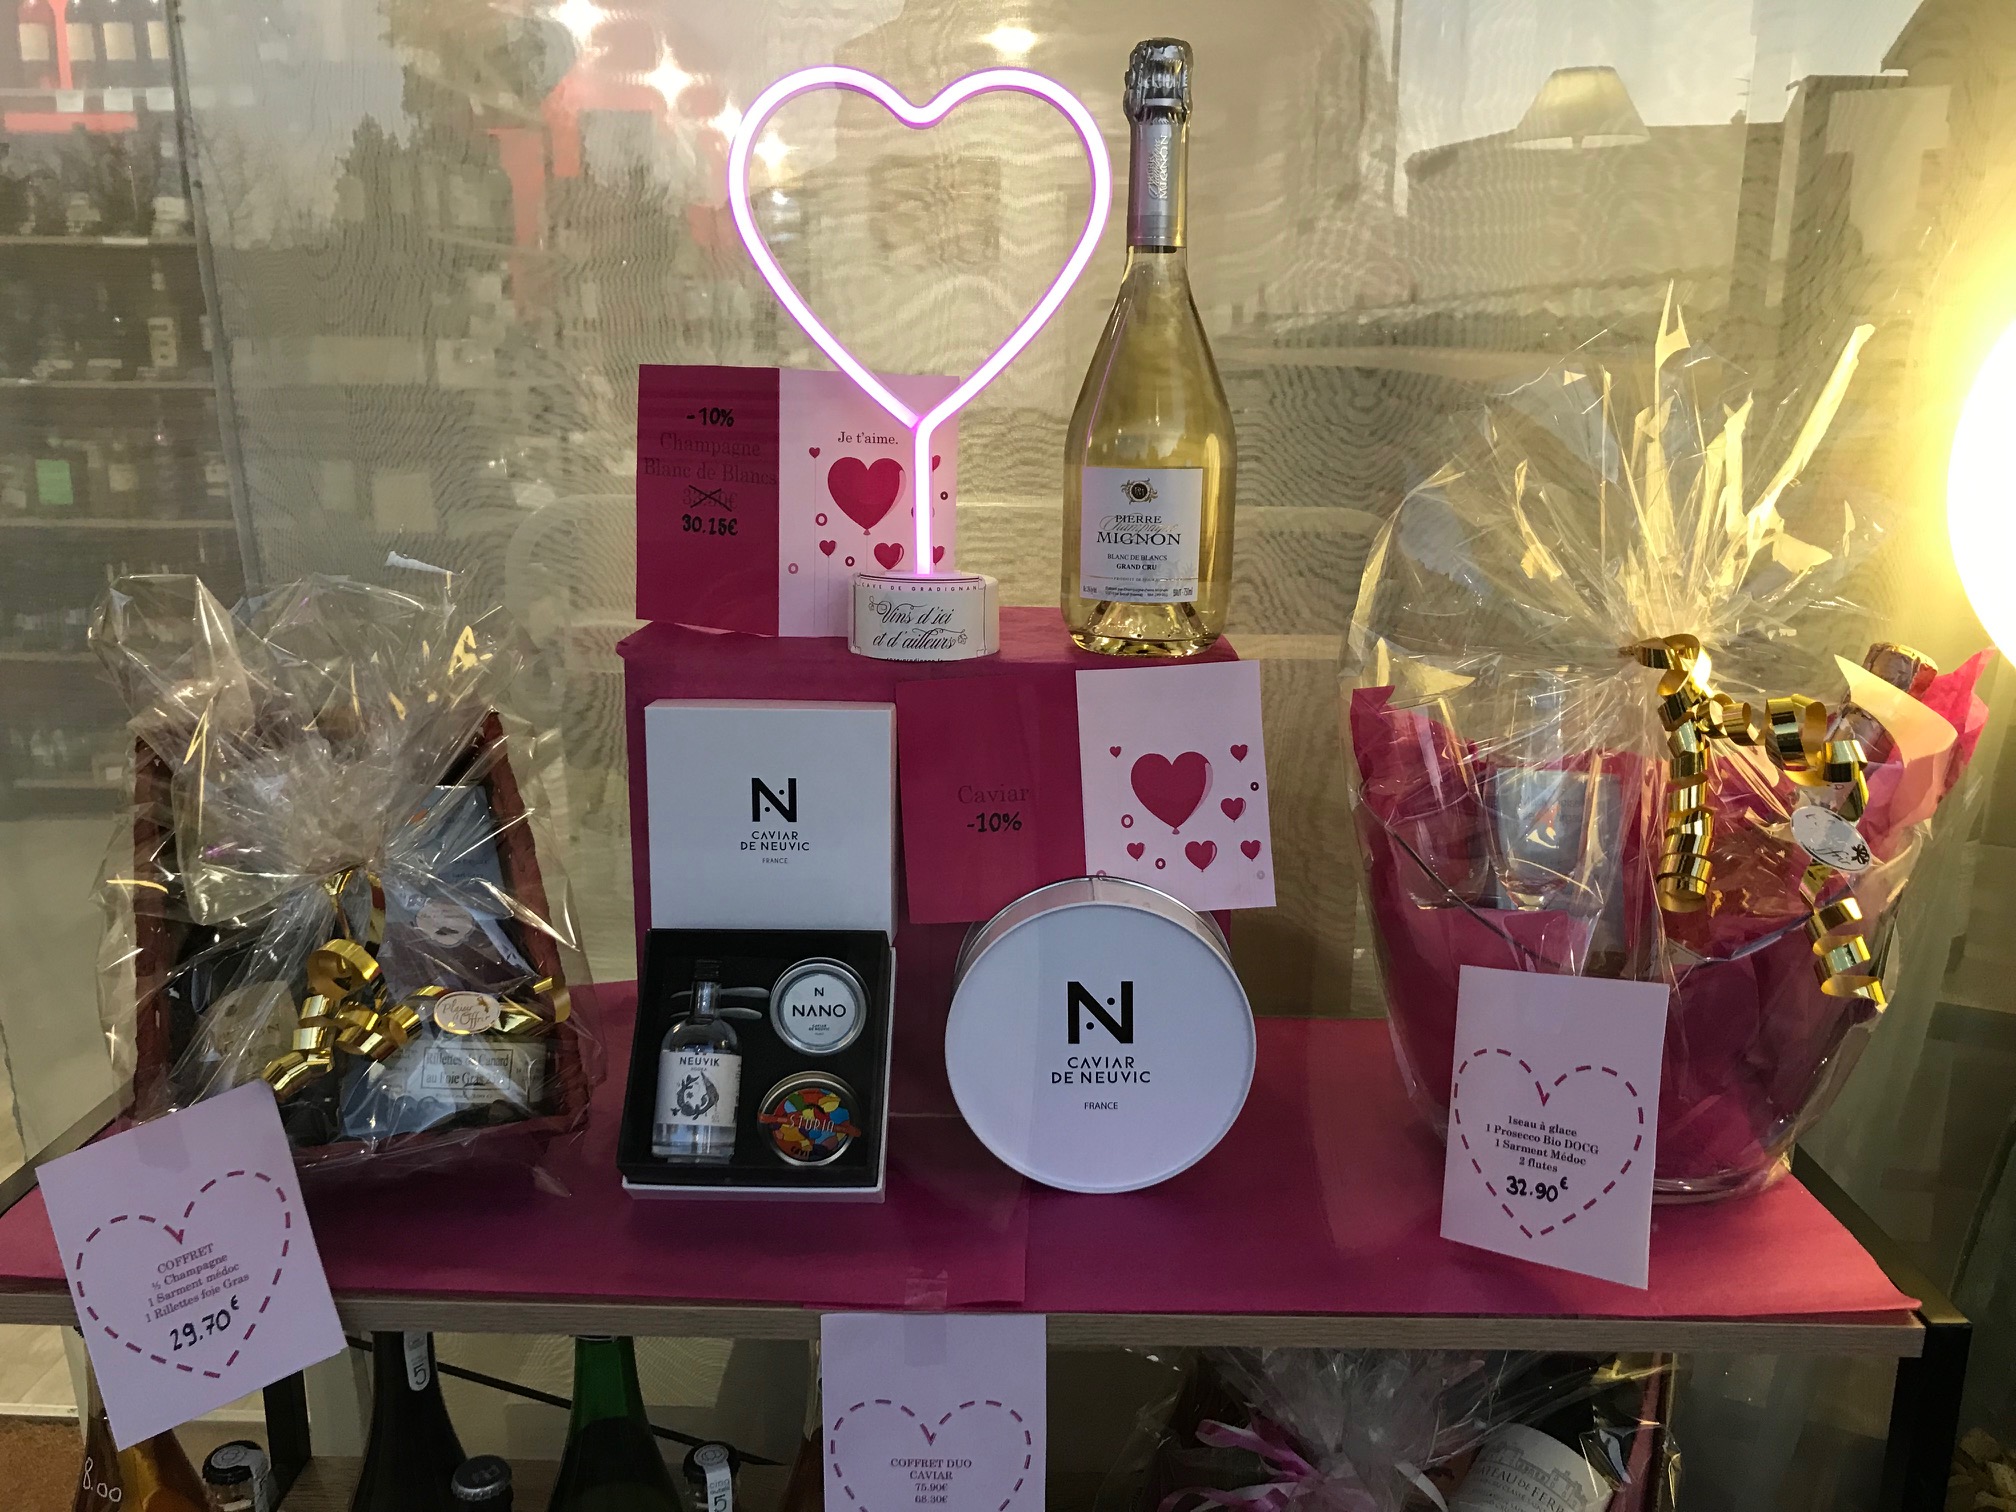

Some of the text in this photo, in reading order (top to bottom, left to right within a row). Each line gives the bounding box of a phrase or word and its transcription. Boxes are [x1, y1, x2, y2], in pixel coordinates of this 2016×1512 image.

[686, 407, 735, 428] -10%
[659, 432, 761, 463] Champagne
[837, 431, 899, 445] Je t'aime.
[643, 457, 777, 486] Blanc de Blancs
[682, 513, 738, 536] 30.15€
[1115, 514, 1162, 524] PIERRE
[1096, 531, 1182, 546] MIGNON
[1107, 553, 1129, 561] BLANC
[876, 601, 915, 624] Vins
[872, 632, 885, 647] et
[751, 777, 798, 823] N
[957, 783, 1030, 805] Caviar
[966, 811, 1022, 833] -10%
[751, 830, 799, 841] CAVIAR
[740, 841, 810, 851] DE NEUVIC
[814, 987, 824, 997] N
[792, 1004, 847, 1017] NANO
[1067, 980, 1134, 1044] N
[679, 1056, 720, 1067] NEUVIK
[1067, 1056, 1135, 1069] CAVIAR
[1051, 1071, 1151, 1083] DE NEUVIC
[1084, 1101, 1118, 1110] FRANCE
[789, 1114, 835, 1133] STURIA
[1539, 1121, 1546, 1131] à
[1548, 1123, 1577, 1137] glace
[1485, 1123, 1599, 1155] 1 Prosecco Bio DOCG
[1495, 1138, 1587, 1166] 1 Sarment Médoc
[1519, 1156, 1558, 1173] 2 flutes
[1505, 1175, 1569, 1203] 32.90€
[157, 1242, 214, 1274] COFFRET
[164, 1253, 228, 1286] Champagne
[148, 1262, 240, 1307] 1 Sarment médoc
[145, 1273, 250, 1323] 1 Rillettes foie Gras
[169, 1294, 240, 1351] 29.70€
[890, 1458, 972, 1469] COFFRET DUO
[83, 1456, 122, 1503] 8.00
[909, 1470, 953, 1480] CAVIAR
